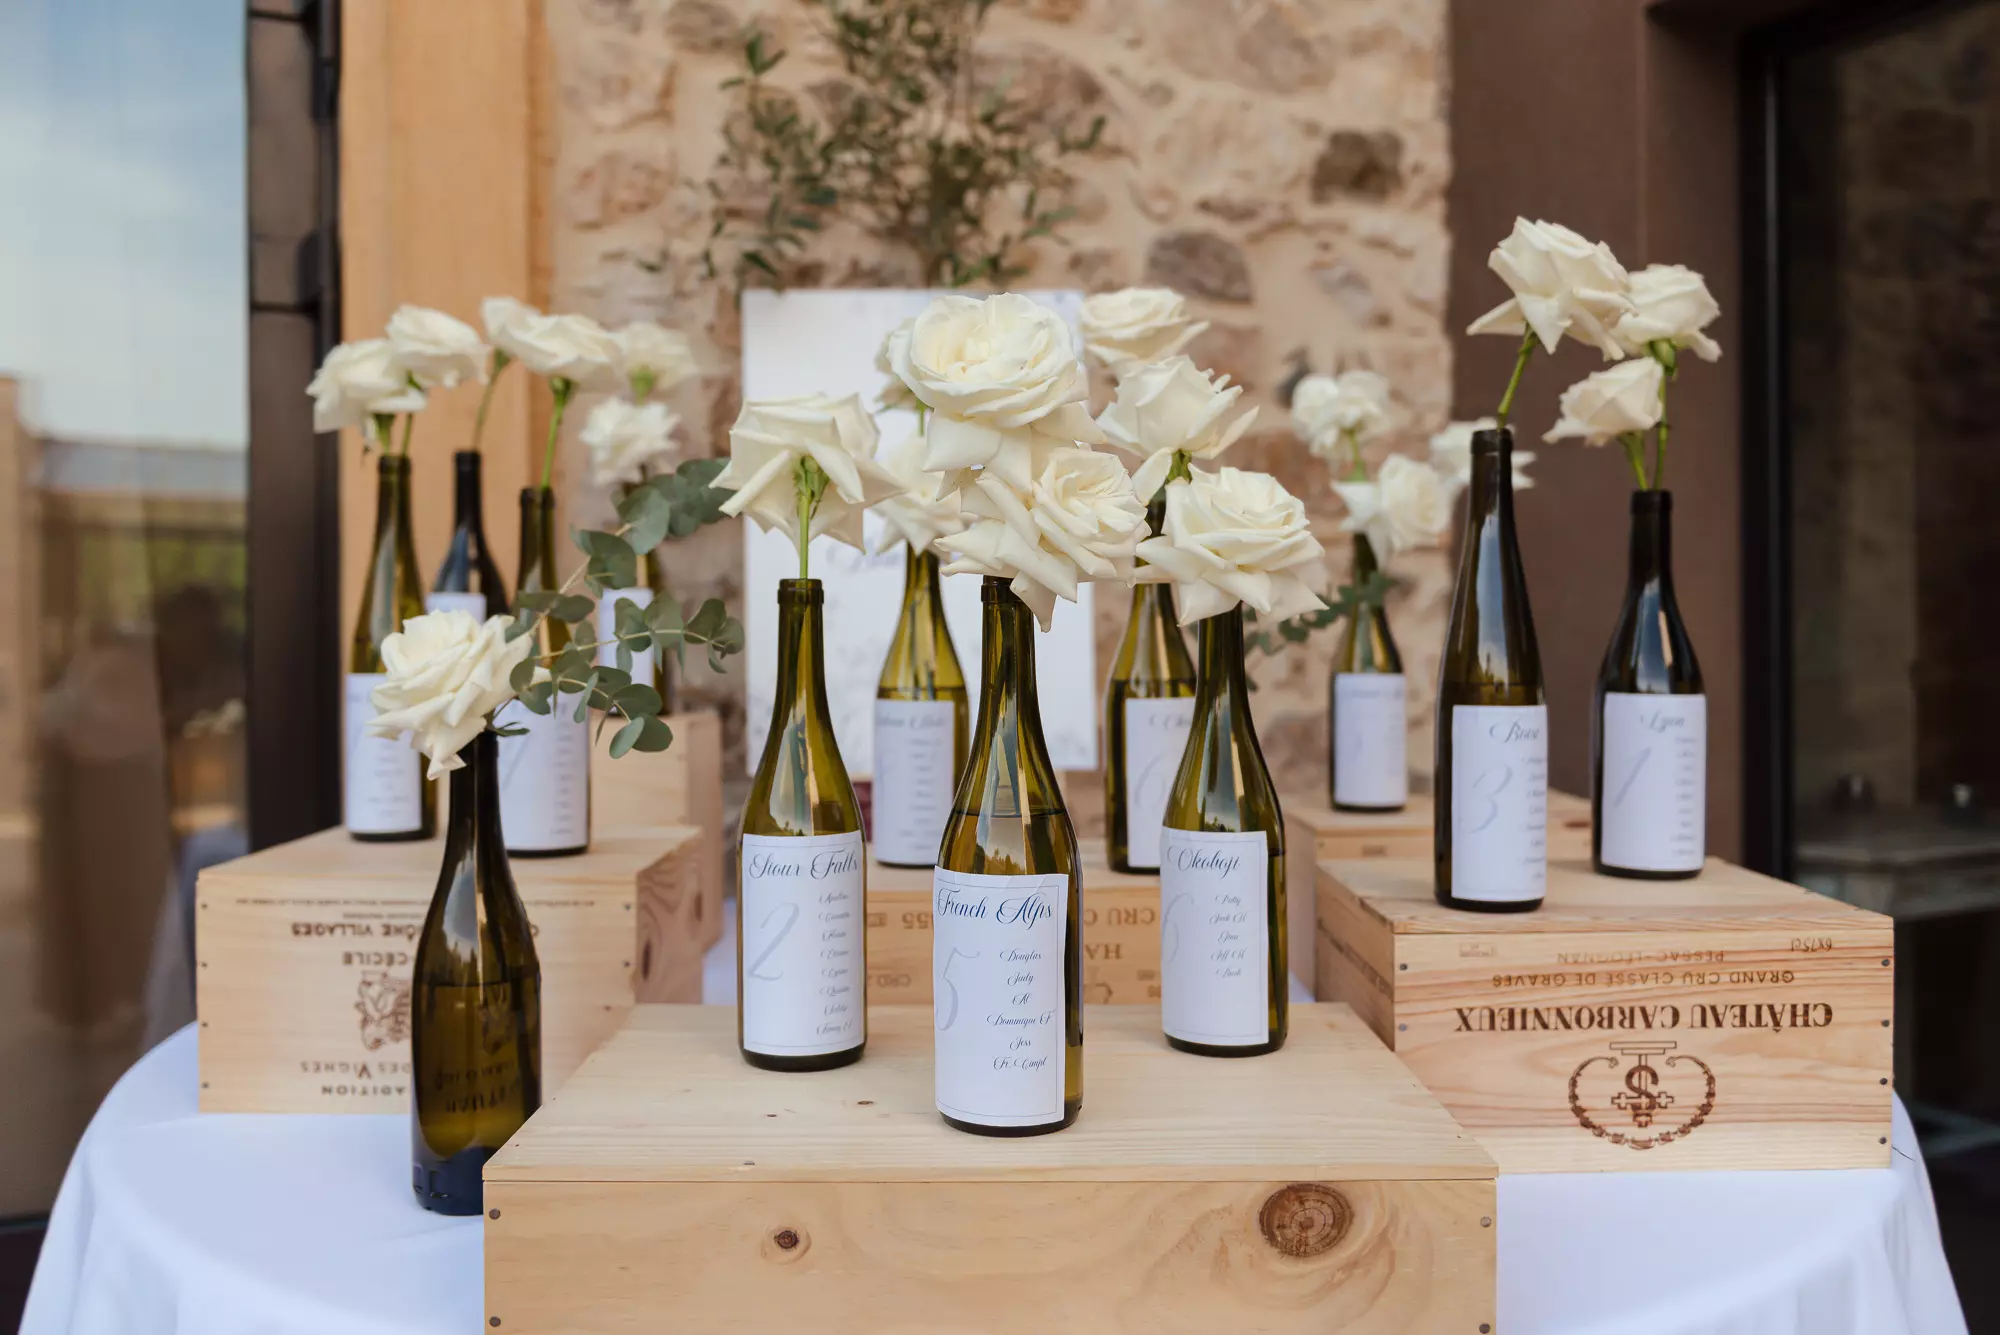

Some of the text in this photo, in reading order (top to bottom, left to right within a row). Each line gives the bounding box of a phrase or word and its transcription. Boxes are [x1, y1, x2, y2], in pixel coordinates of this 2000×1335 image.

[1460, 763, 1513, 835] 3
[749, 849, 859, 880] Sioux Falls
[936, 888, 989, 919] French
[996, 891, 1053, 930] Alps
[1108, 907, 1156, 926] CRU
[291, 923, 373, 937] VILLAGES
[900, 912, 935, 930] 55
[749, 902, 800, 982] 2
[1083, 942, 1123, 960] HA
[342, 951, 414, 967] -CÉCILE
[999, 948, 1042, 963] Douglas
[1007, 971, 1034, 986] Judy
[1492, 969, 1794, 988] GRAND CRU CLASSÉ DE GRAVES
[935, 947, 981, 1031] 5
[986, 1012, 1037, 1029] Dominique
[1454, 1001, 1833, 1033] CHÂTEAU CARBONNIEUX
[1009, 1036, 1031, 1051] Jess
[321, 1085, 407, 1096] ADITION
